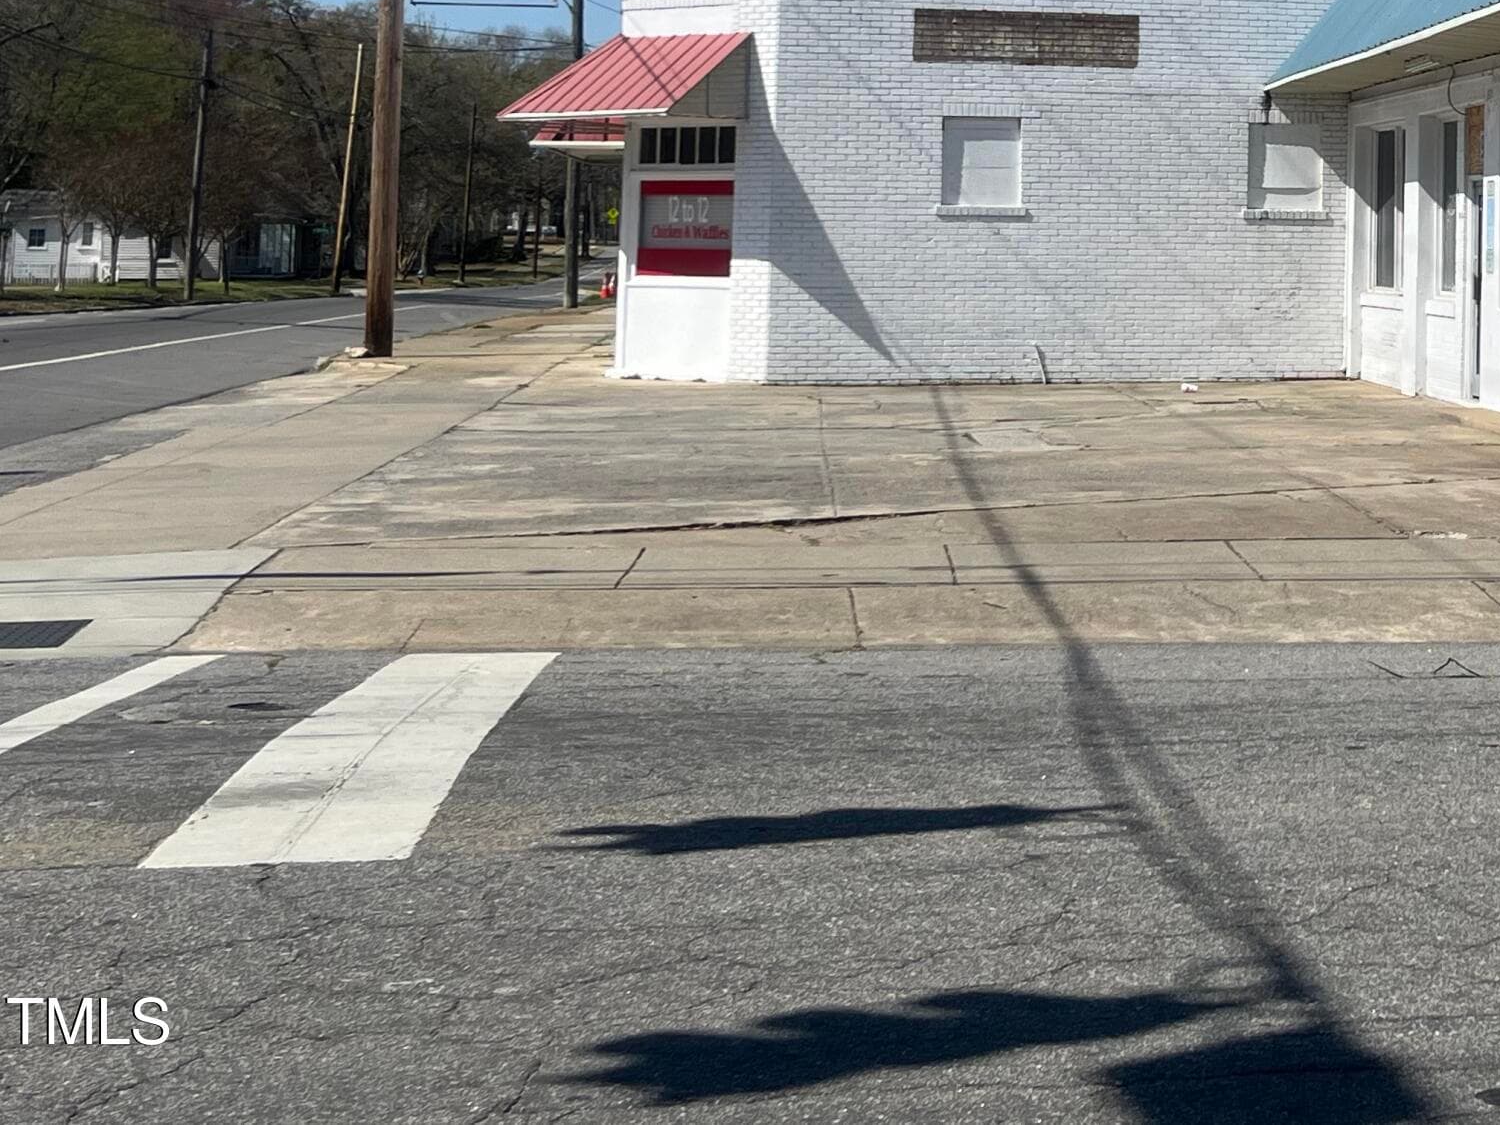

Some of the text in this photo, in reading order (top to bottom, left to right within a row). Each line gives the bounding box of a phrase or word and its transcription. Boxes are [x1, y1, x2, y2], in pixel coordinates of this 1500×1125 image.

[668, 196, 710, 223] 12 to 12
